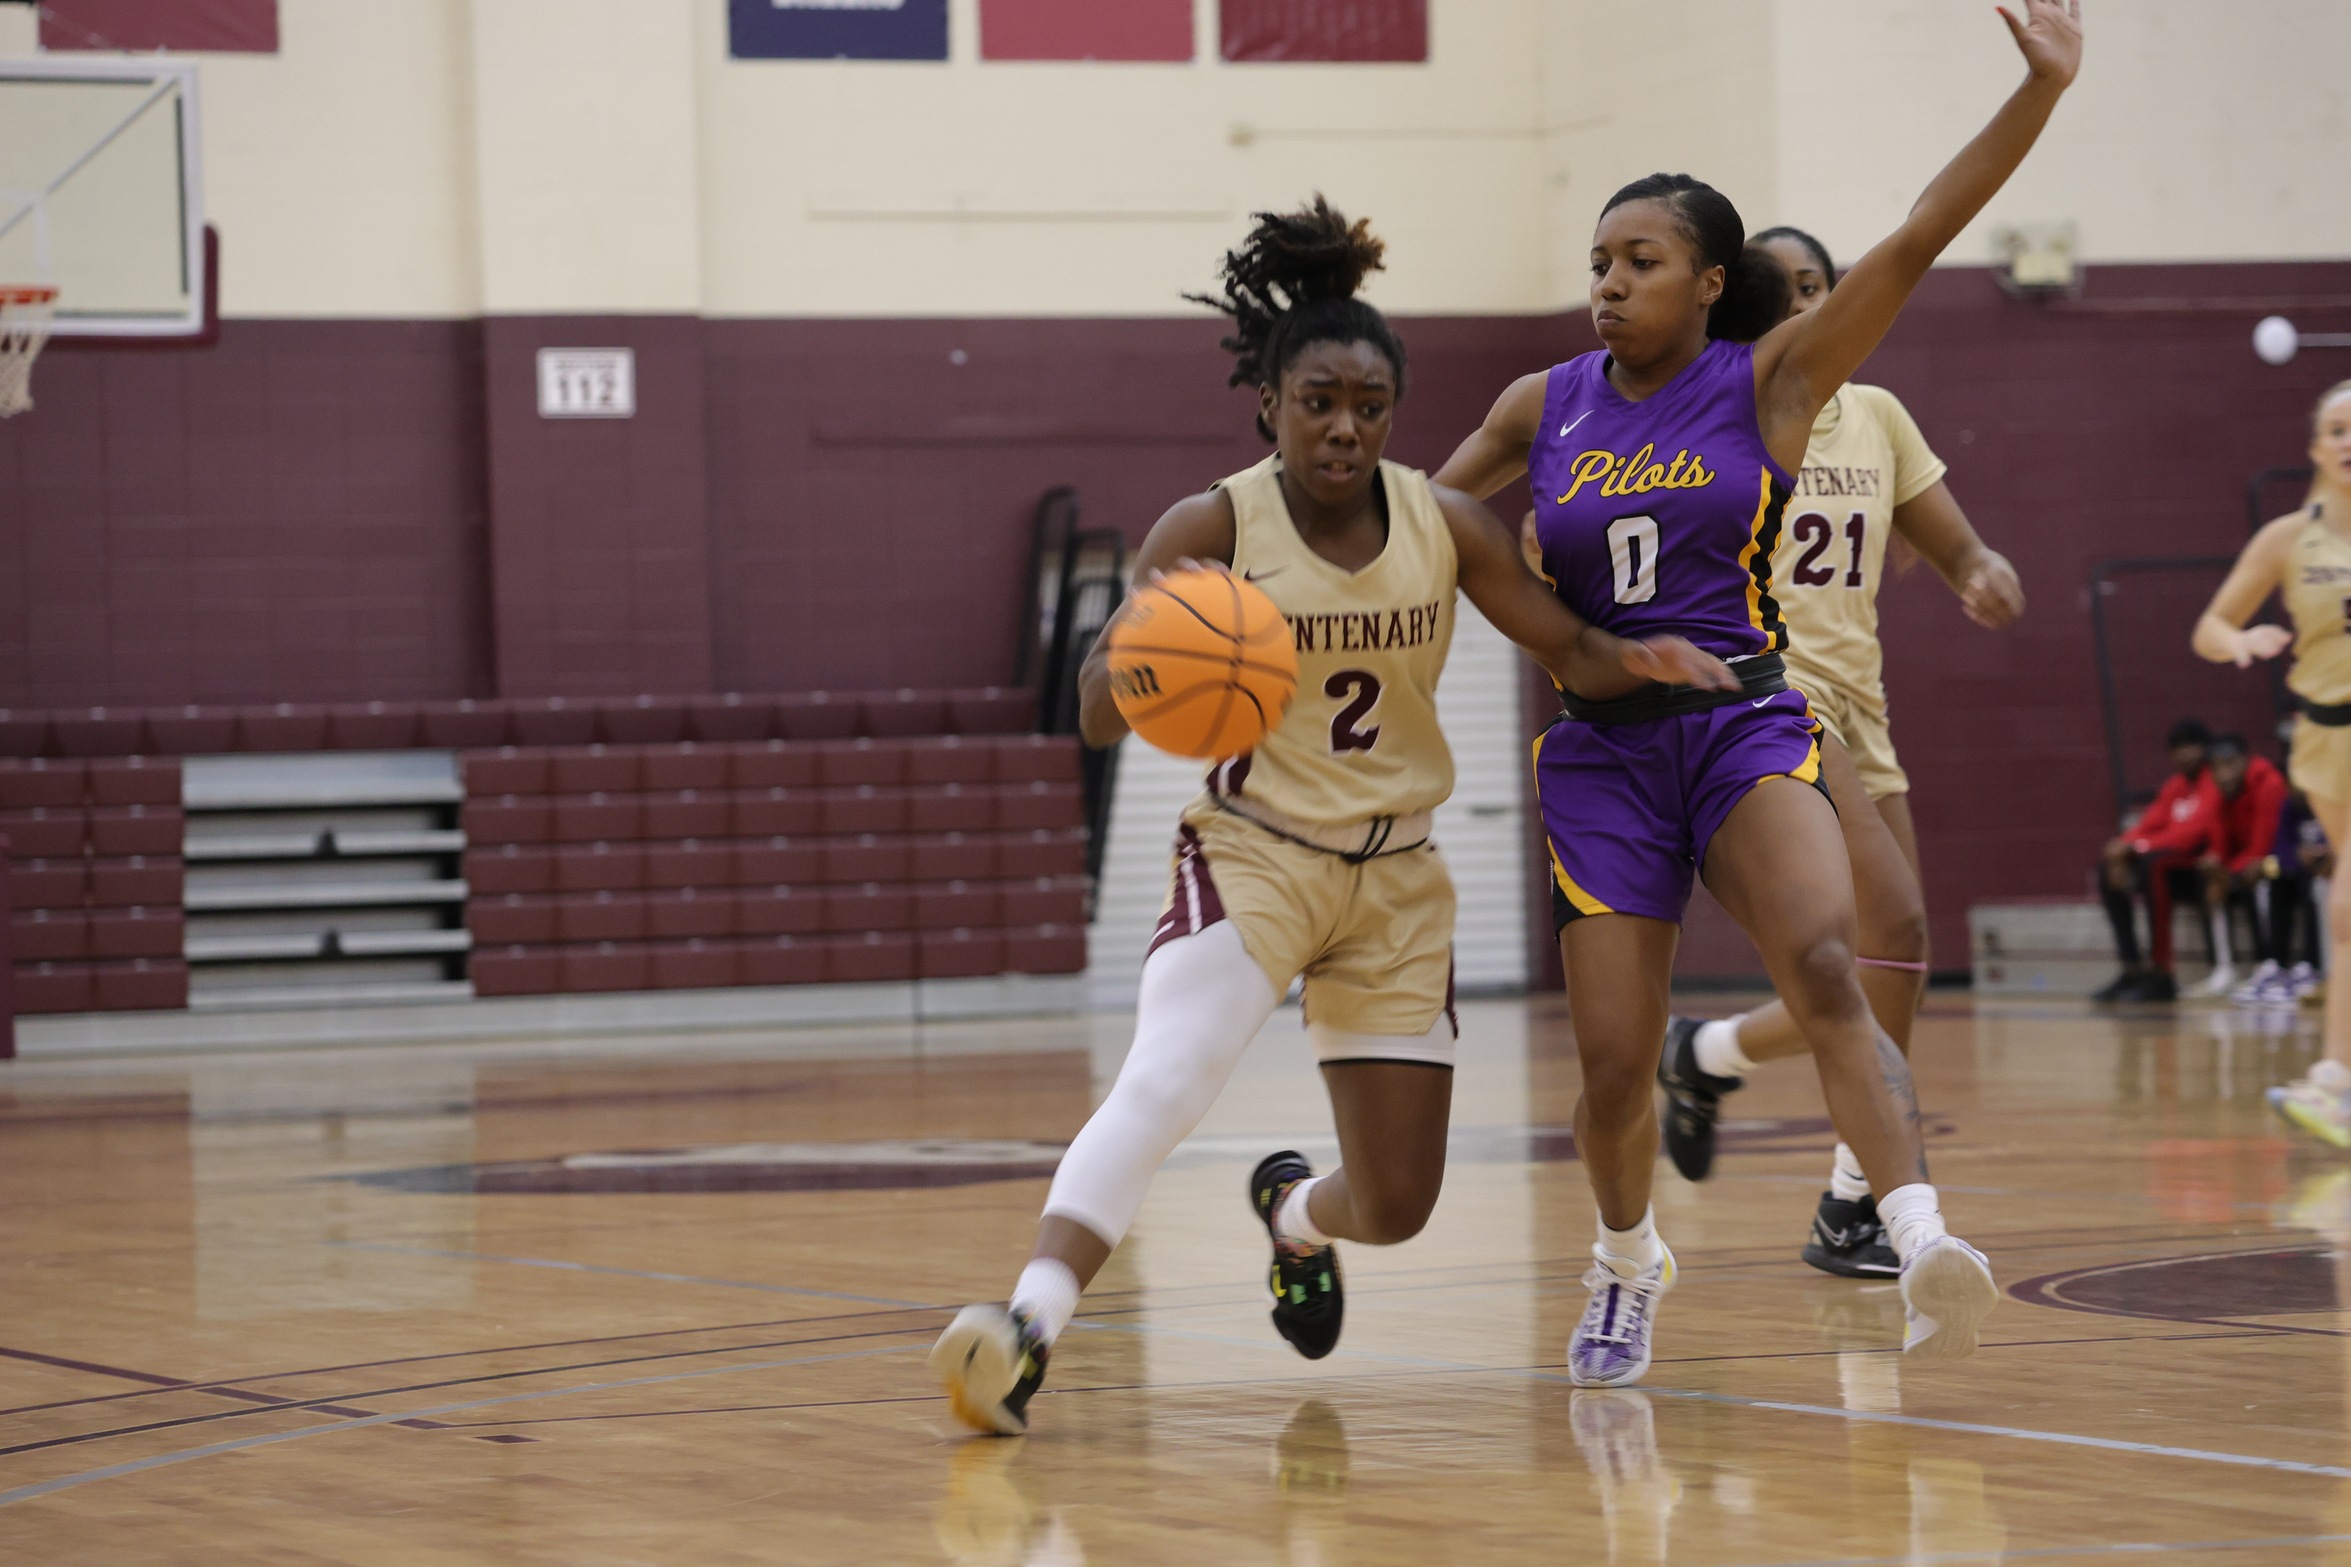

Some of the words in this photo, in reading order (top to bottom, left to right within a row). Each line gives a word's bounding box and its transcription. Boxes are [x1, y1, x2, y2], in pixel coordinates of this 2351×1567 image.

[1557, 442, 1716, 505] Pilots
[1793, 467, 1880, 497] TENARY
[1605, 514, 1661, 605] 0
[1792, 510, 1867, 590] 21
[1283, 600, 1440, 653] NTENARY
[1323, 666, 1383, 756] 2
